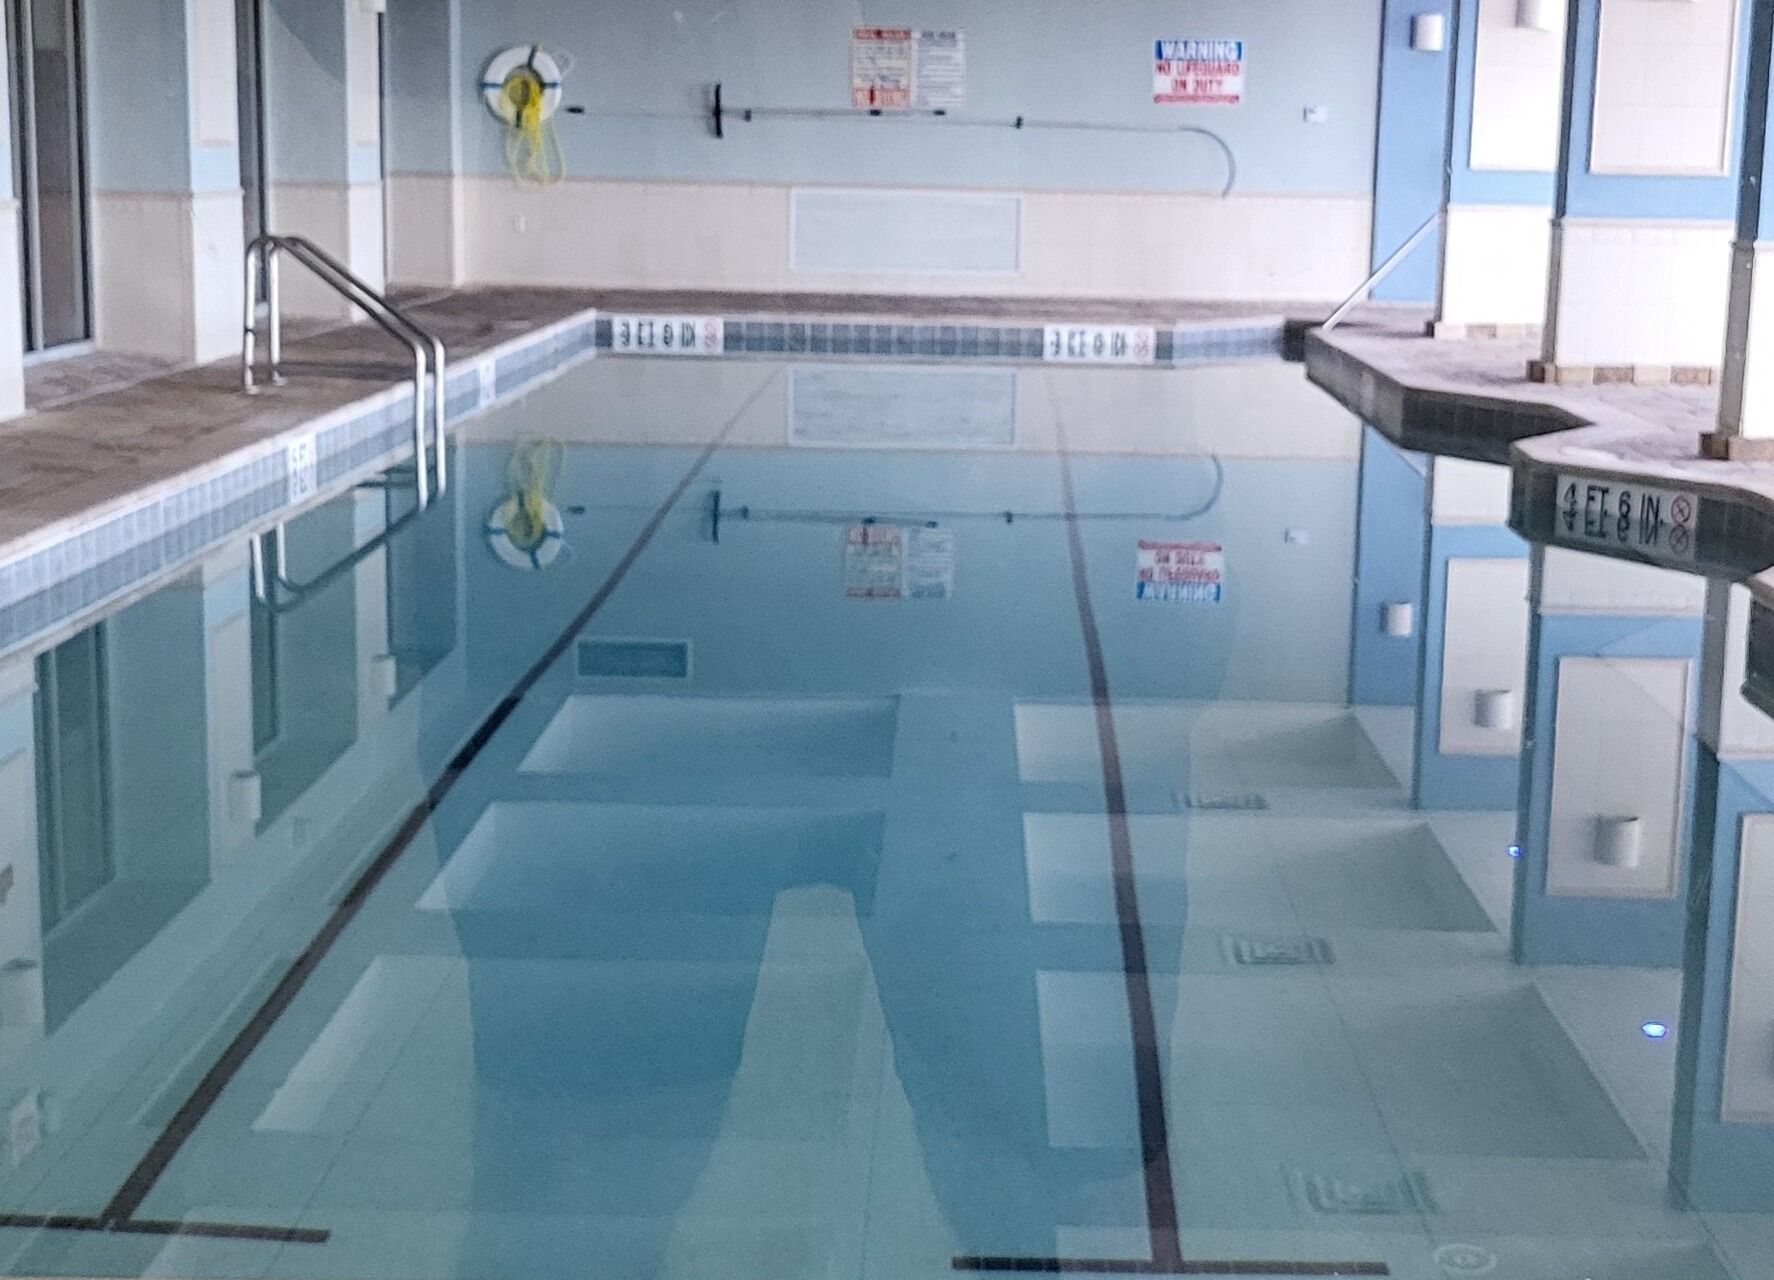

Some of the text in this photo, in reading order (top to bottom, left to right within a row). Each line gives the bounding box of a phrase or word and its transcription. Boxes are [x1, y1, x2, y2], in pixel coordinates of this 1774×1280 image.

[1161, 41, 1238, 61] WARNING
[1156, 62, 1239, 77] NO LIFEGUARD
[1171, 79, 1223, 93] ON DUTY
[1563, 483, 1577, 509] 4
[1619, 490, 1631, 518] 6
